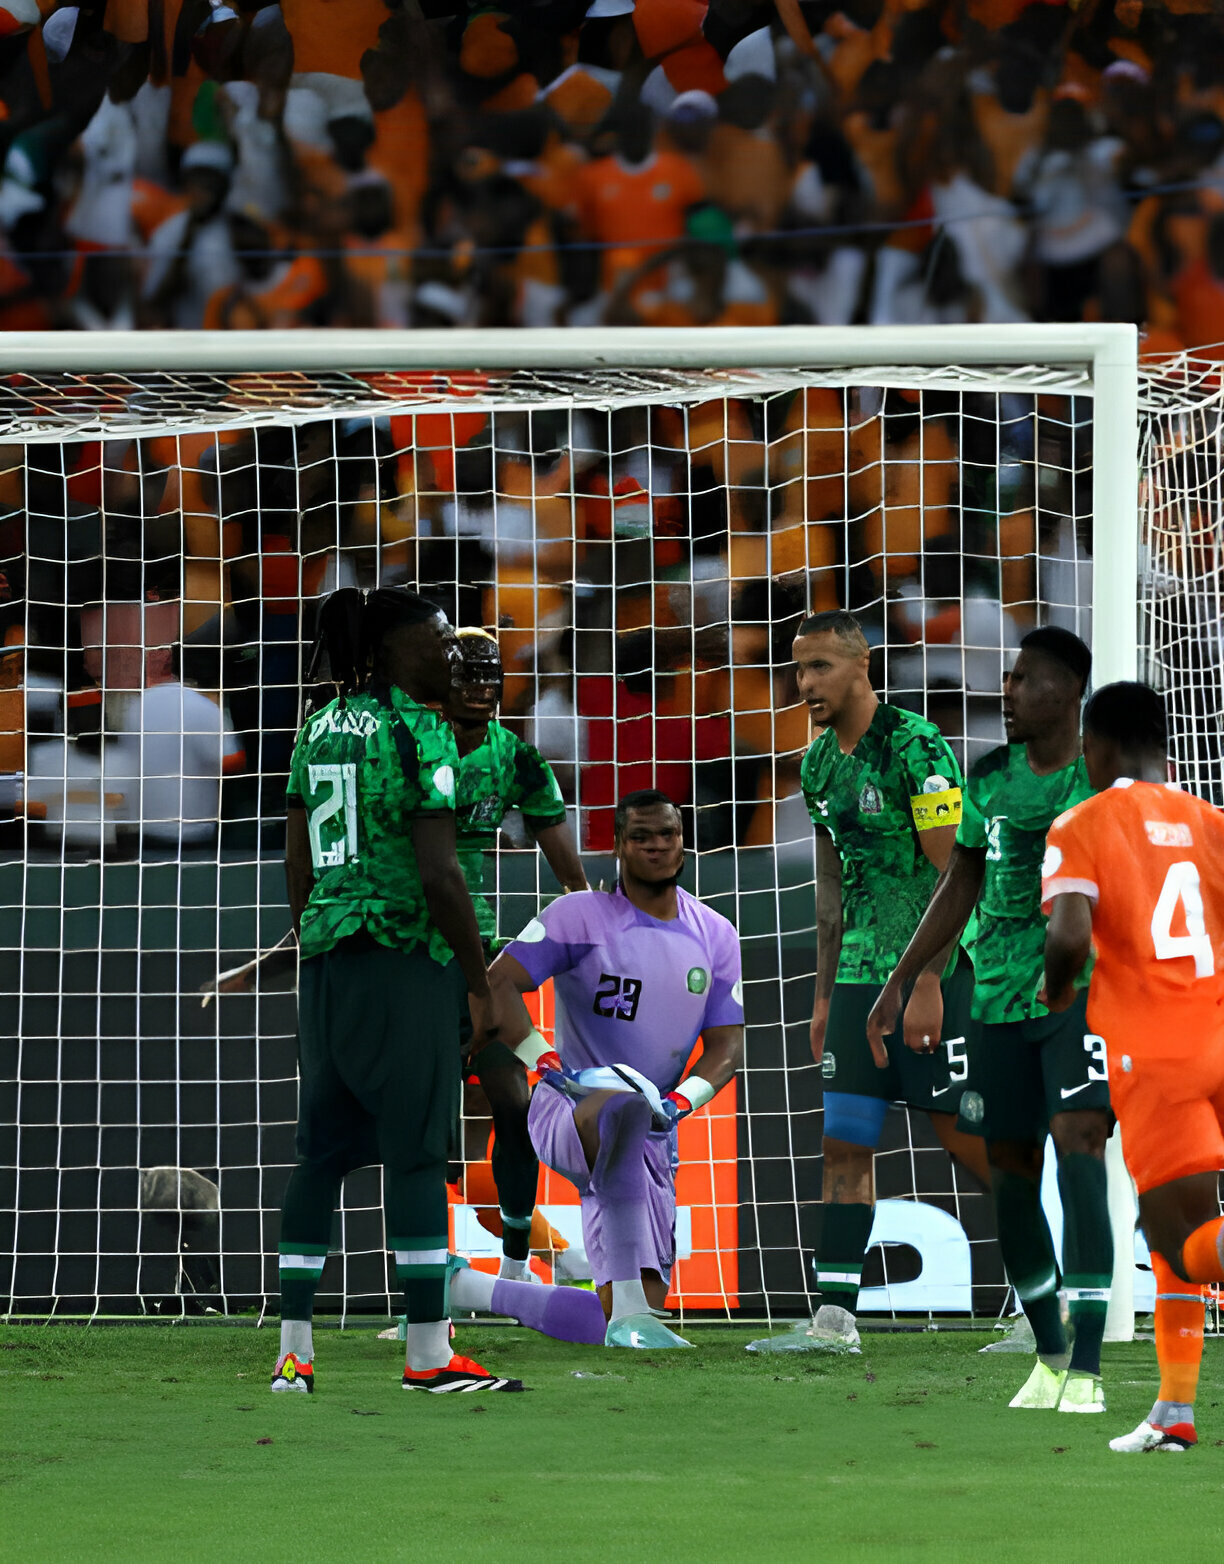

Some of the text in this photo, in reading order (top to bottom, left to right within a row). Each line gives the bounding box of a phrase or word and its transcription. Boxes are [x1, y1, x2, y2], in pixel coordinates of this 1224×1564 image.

[308, 763, 359, 868] 21
[1151, 861, 1215, 978] 4
[593, 973, 642, 1022] 23
[946, 1036, 969, 1082] 5
[1083, 1034, 1109, 1082] 3
